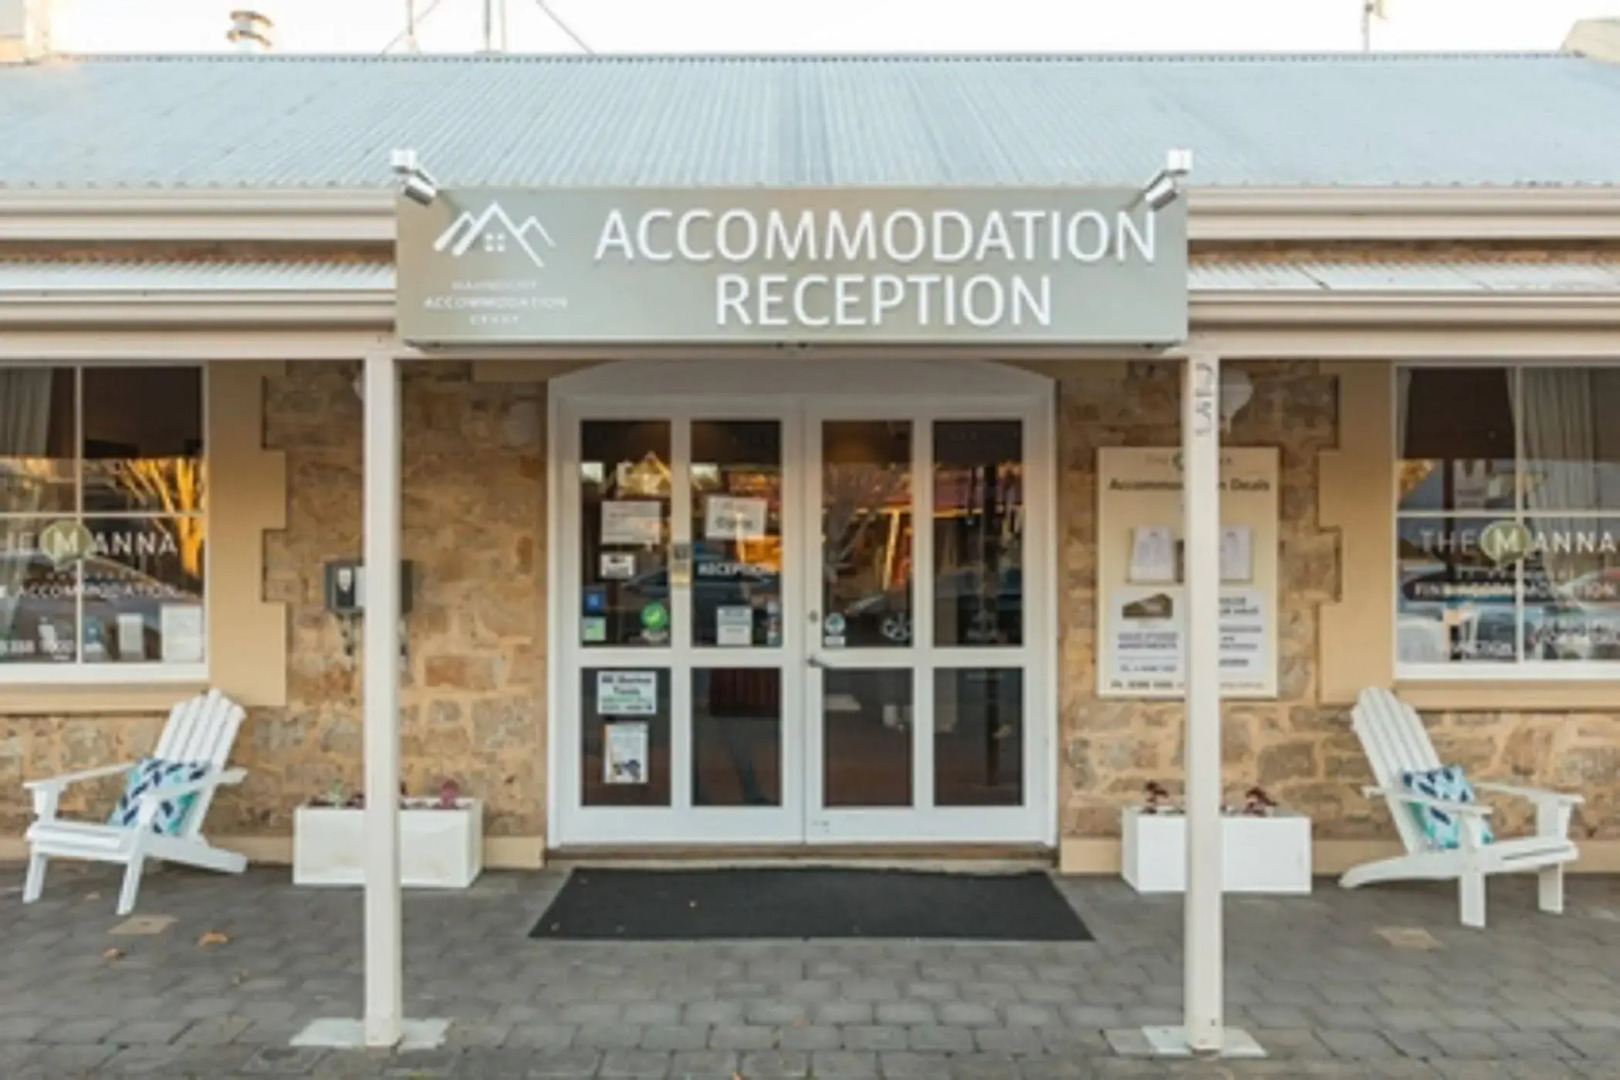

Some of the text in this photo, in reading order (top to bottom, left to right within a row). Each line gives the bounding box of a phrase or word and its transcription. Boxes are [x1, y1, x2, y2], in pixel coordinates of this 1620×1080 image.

[594, 208, 1156, 262] ACCOMMODATION
[716, 273, 1052, 327] RECEPTION
[1419, 527, 1617, 555] THE MANNA
